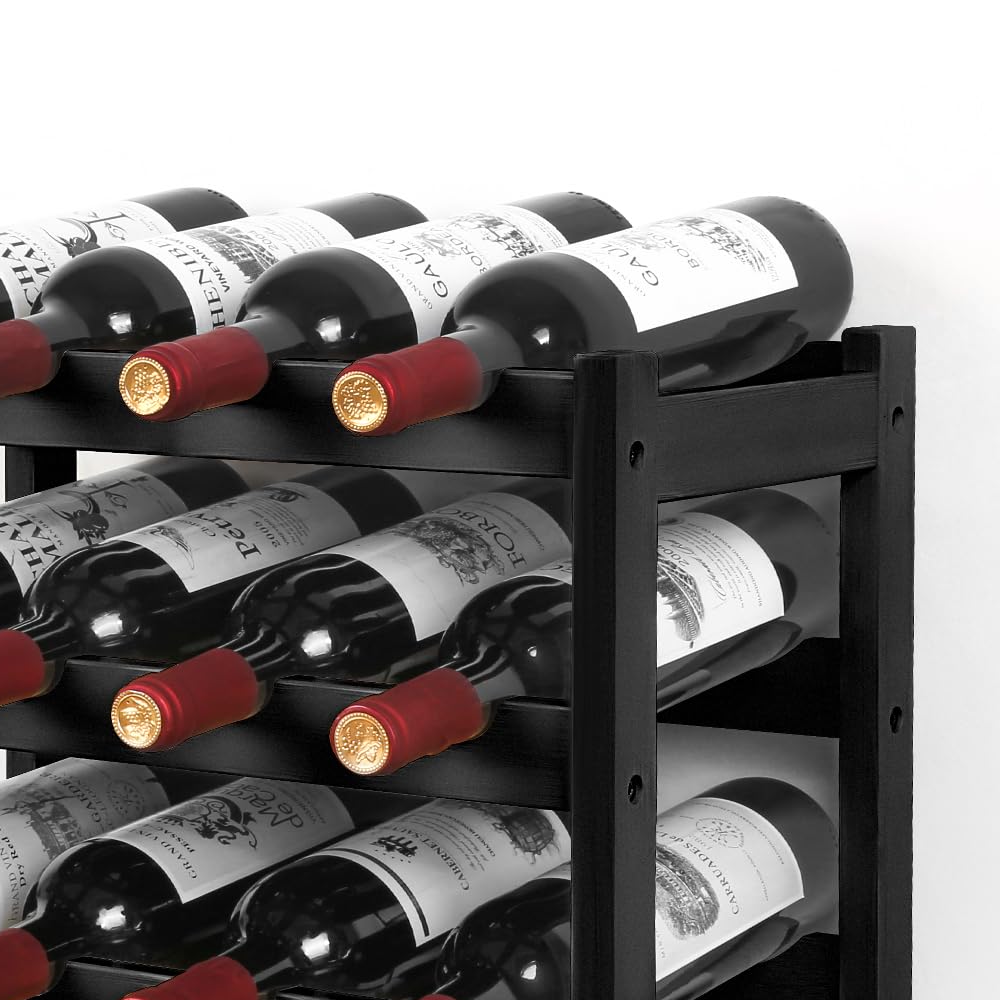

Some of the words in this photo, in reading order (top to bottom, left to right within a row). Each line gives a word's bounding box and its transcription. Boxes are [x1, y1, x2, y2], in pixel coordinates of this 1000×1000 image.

[2, 836, 19, 860] Red
[160, 841, 197, 880] GRAND
[421, 837, 470, 890] CABERNET
[17, 863, 27, 887] Dry
[684, 842, 740, 915] CARRUADES
